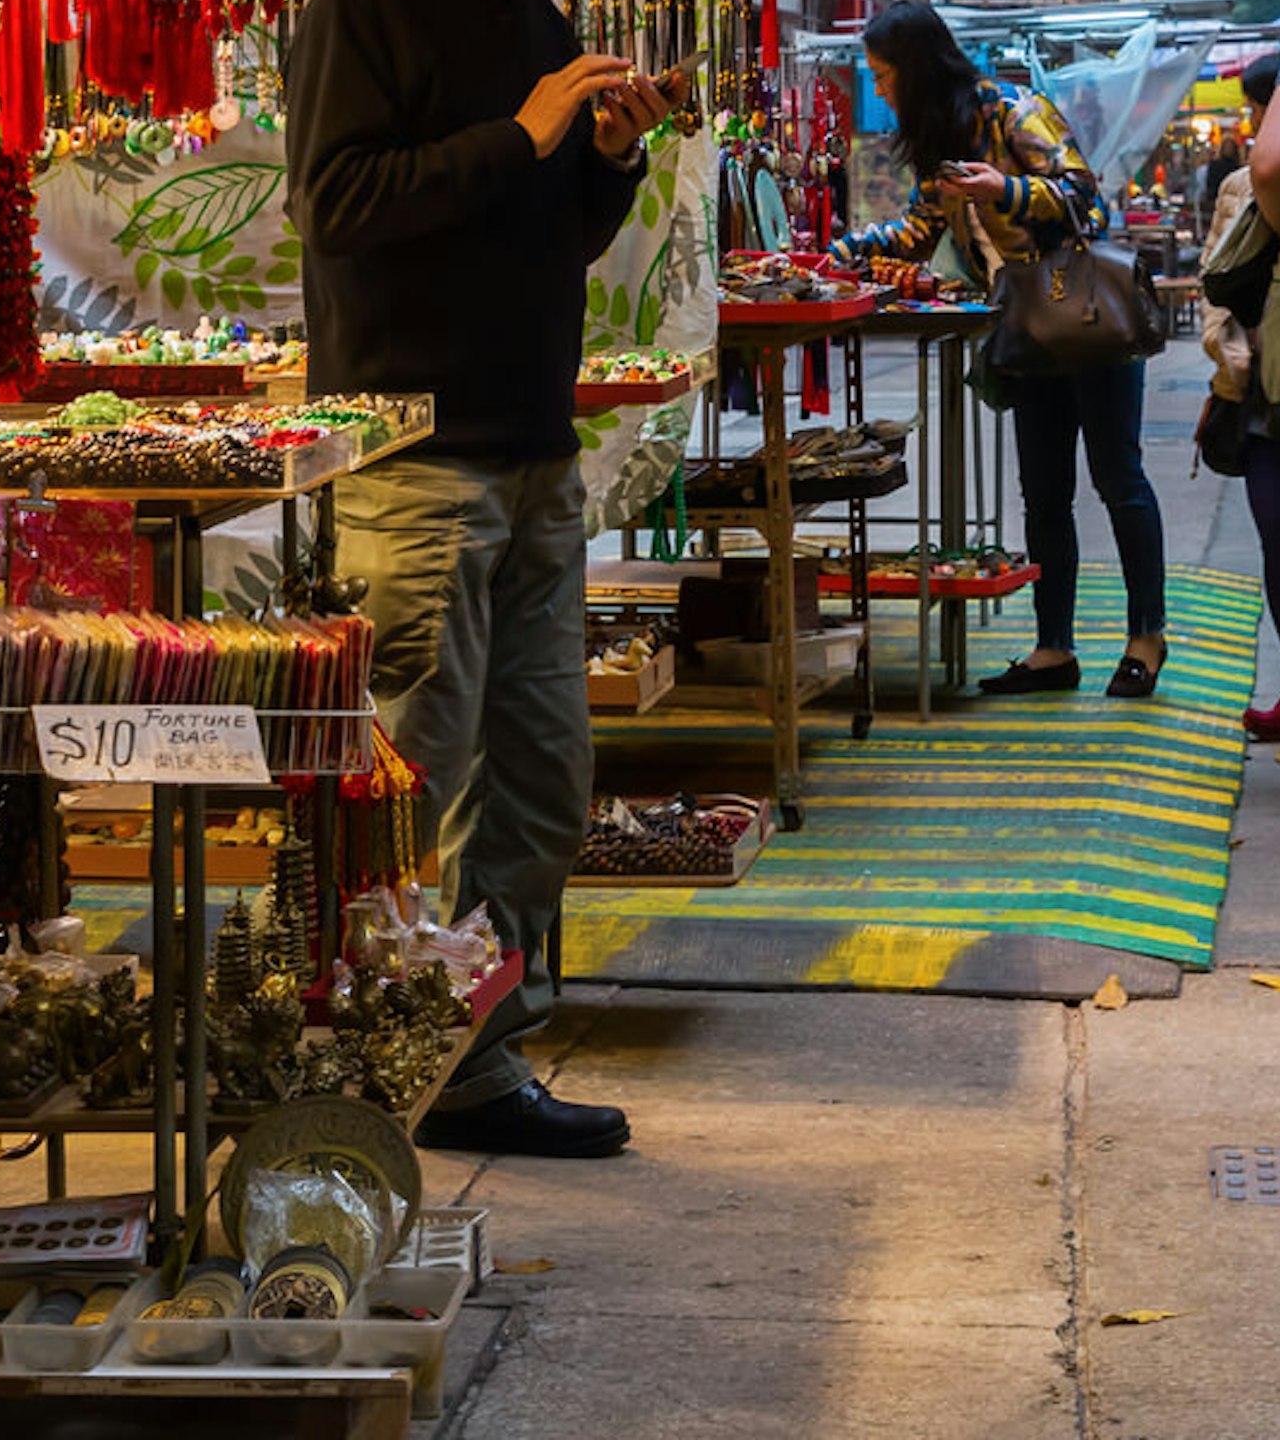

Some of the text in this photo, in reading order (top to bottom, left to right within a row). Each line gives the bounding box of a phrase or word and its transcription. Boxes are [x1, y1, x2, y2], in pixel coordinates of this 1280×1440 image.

[143, 707, 248, 729] FORTUNE
[46, 716, 136, 768] $10
[169, 729, 219, 745] BAG
